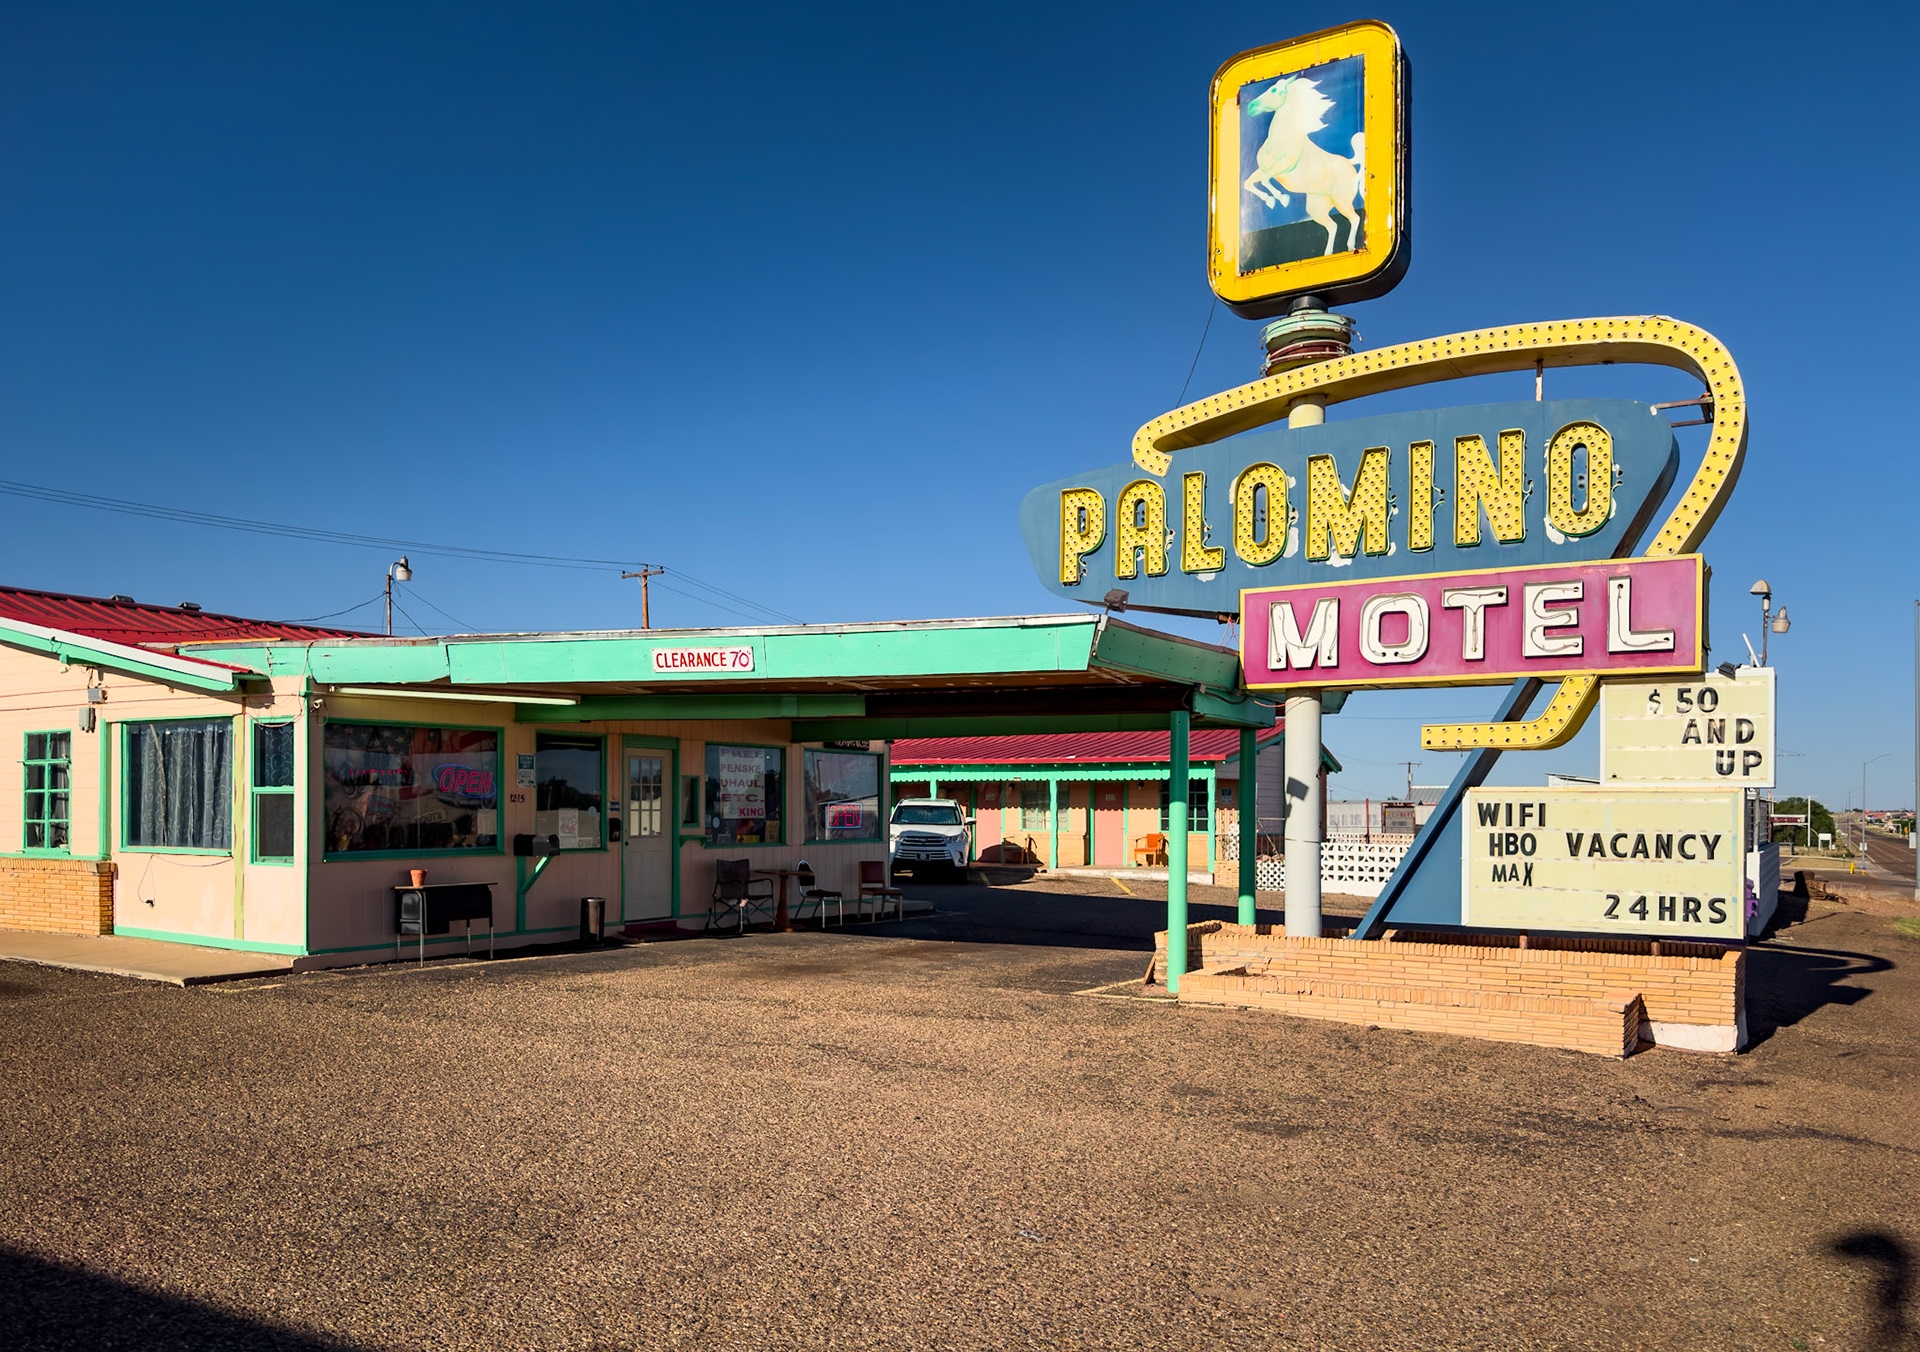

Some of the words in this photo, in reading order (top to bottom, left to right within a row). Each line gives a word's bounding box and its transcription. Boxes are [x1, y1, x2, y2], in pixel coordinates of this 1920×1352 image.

[1060, 420, 1613, 586] PALOMINO
[1268, 576, 1674, 669] MOTEL
[656, 652, 727, 668] CLEARANCE
[1648, 688, 1661, 714] $
[1676, 687, 1719, 714] 50
[1681, 718, 1755, 745] AND
[720, 748, 764, 759] FREE
[1715, 750, 1763, 776] UP
[439, 768, 493, 794] OPEN
[721, 778, 764, 790] UHAUL,
[510, 793, 525, 804] 1215
[721, 793, 765, 803] ETC.
[828, 804, 861, 827] OPEN
[1477, 803, 1546, 827] WIFI
[1489, 833, 1537, 857] HBO
[1566, 833, 1721, 860] VACANCY
[1492, 862, 1533, 887] MAX
[1603, 894, 1727, 924] 24HRS
